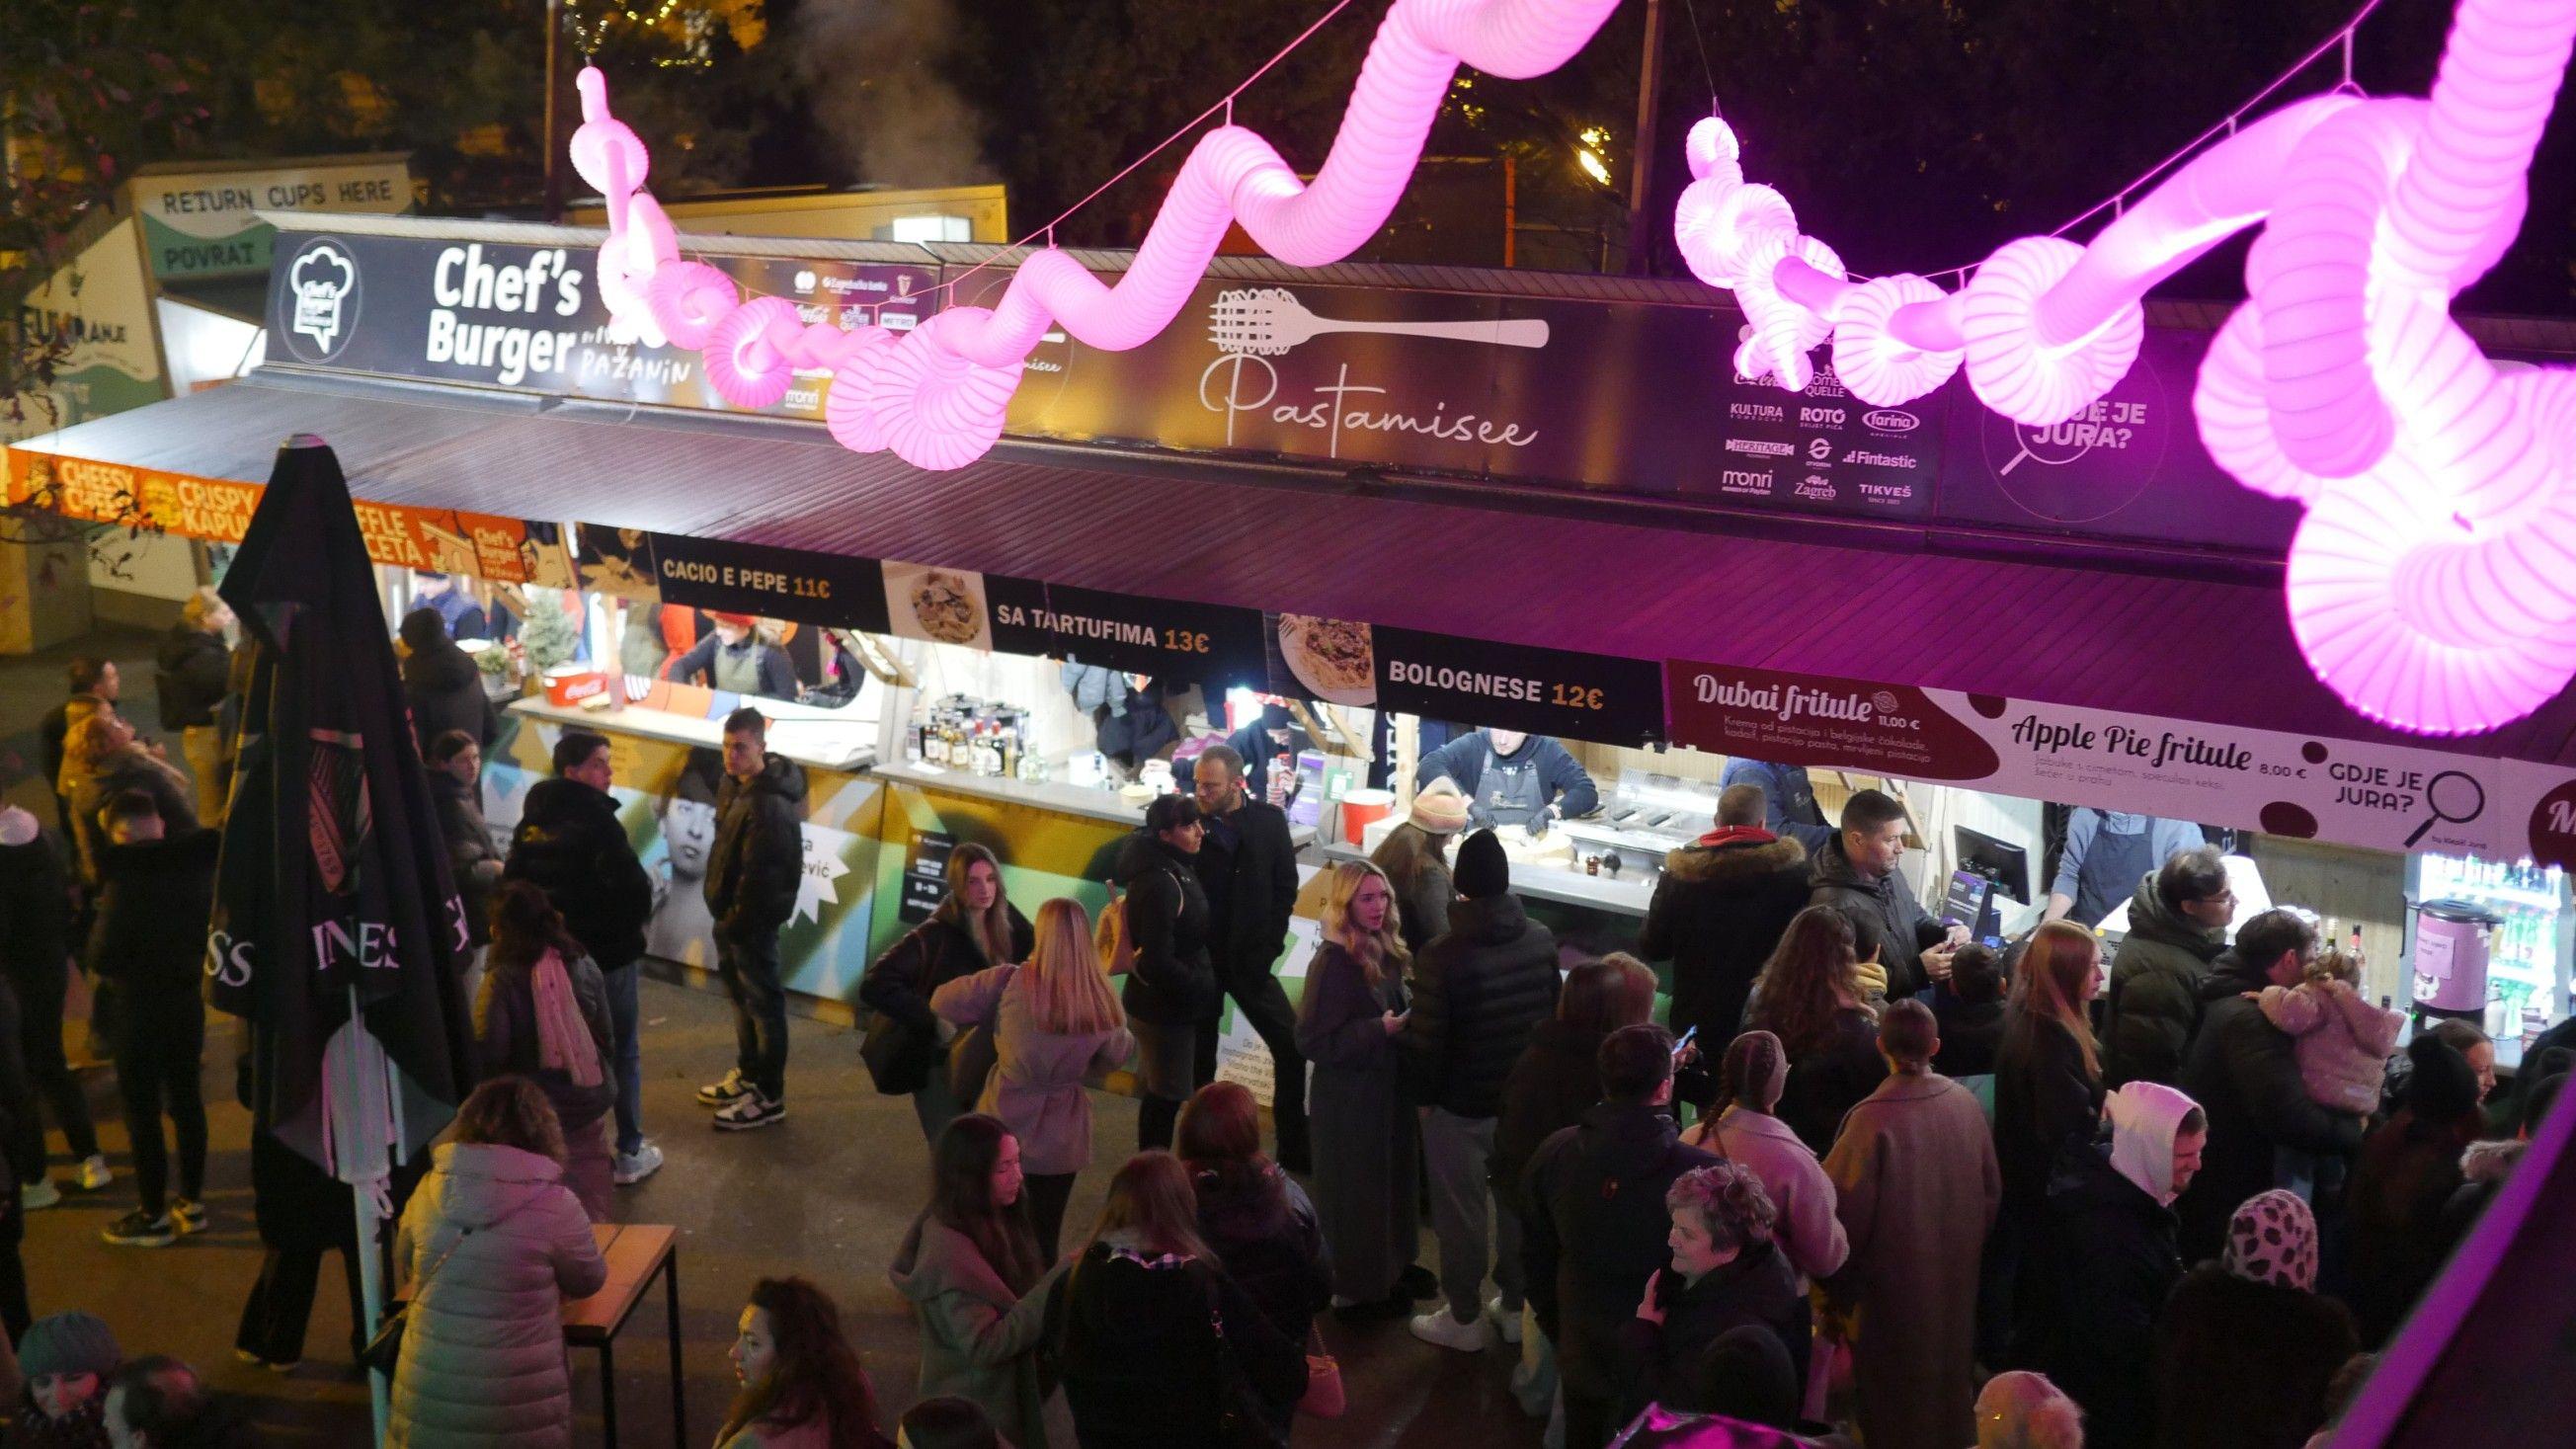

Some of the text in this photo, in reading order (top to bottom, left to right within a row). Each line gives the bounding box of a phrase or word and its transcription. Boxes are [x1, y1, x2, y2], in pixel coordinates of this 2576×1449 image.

[163, 180, 392, 214] RETURN CUPS HERE
[165, 242, 254, 271] POVRAT
[434, 243, 584, 316] Chef's
[427, 309, 578, 386] Burger
[1199, 353, 1540, 458] Pastamisee
[1805, 385, 1846, 398] QUELLE
[1731, 403, 1784, 418] KULTURA
[1800, 407, 1846, 425] ROTO
[1871, 413, 1912, 429] farina
[2112, 402, 2147, 425] JE
[2032, 423, 2133, 449] JURA?
[1857, 450, 1917, 469] Fintastic
[1723, 469, 1774, 488] monri
[1795, 482, 1837, 500] Zagreb
[1859, 483, 1912, 498] TIKVEŠ
[177, 479, 255, 516] CRISPY
[663, 558, 830, 600] CACIO E PEPE 11€
[998, 604, 1210, 654] SA TARTUFIMA 13€
[1389, 660, 1605, 711] BOLOGNESE 12€
[1693, 674, 1779, 712] Dubai
[1778, 684, 1874, 723] fritule
[1909, 719, 1921, 730] €
[2012, 714, 2096, 754] Apple
[2104, 725, 2151, 758] Pie
[2150, 731, 2253, 771] fritule
[2295, 767, 2308, 780] €
[2329, 762, 2424, 791] GDJE JE
[2335, 786, 2415, 814] JURA?
